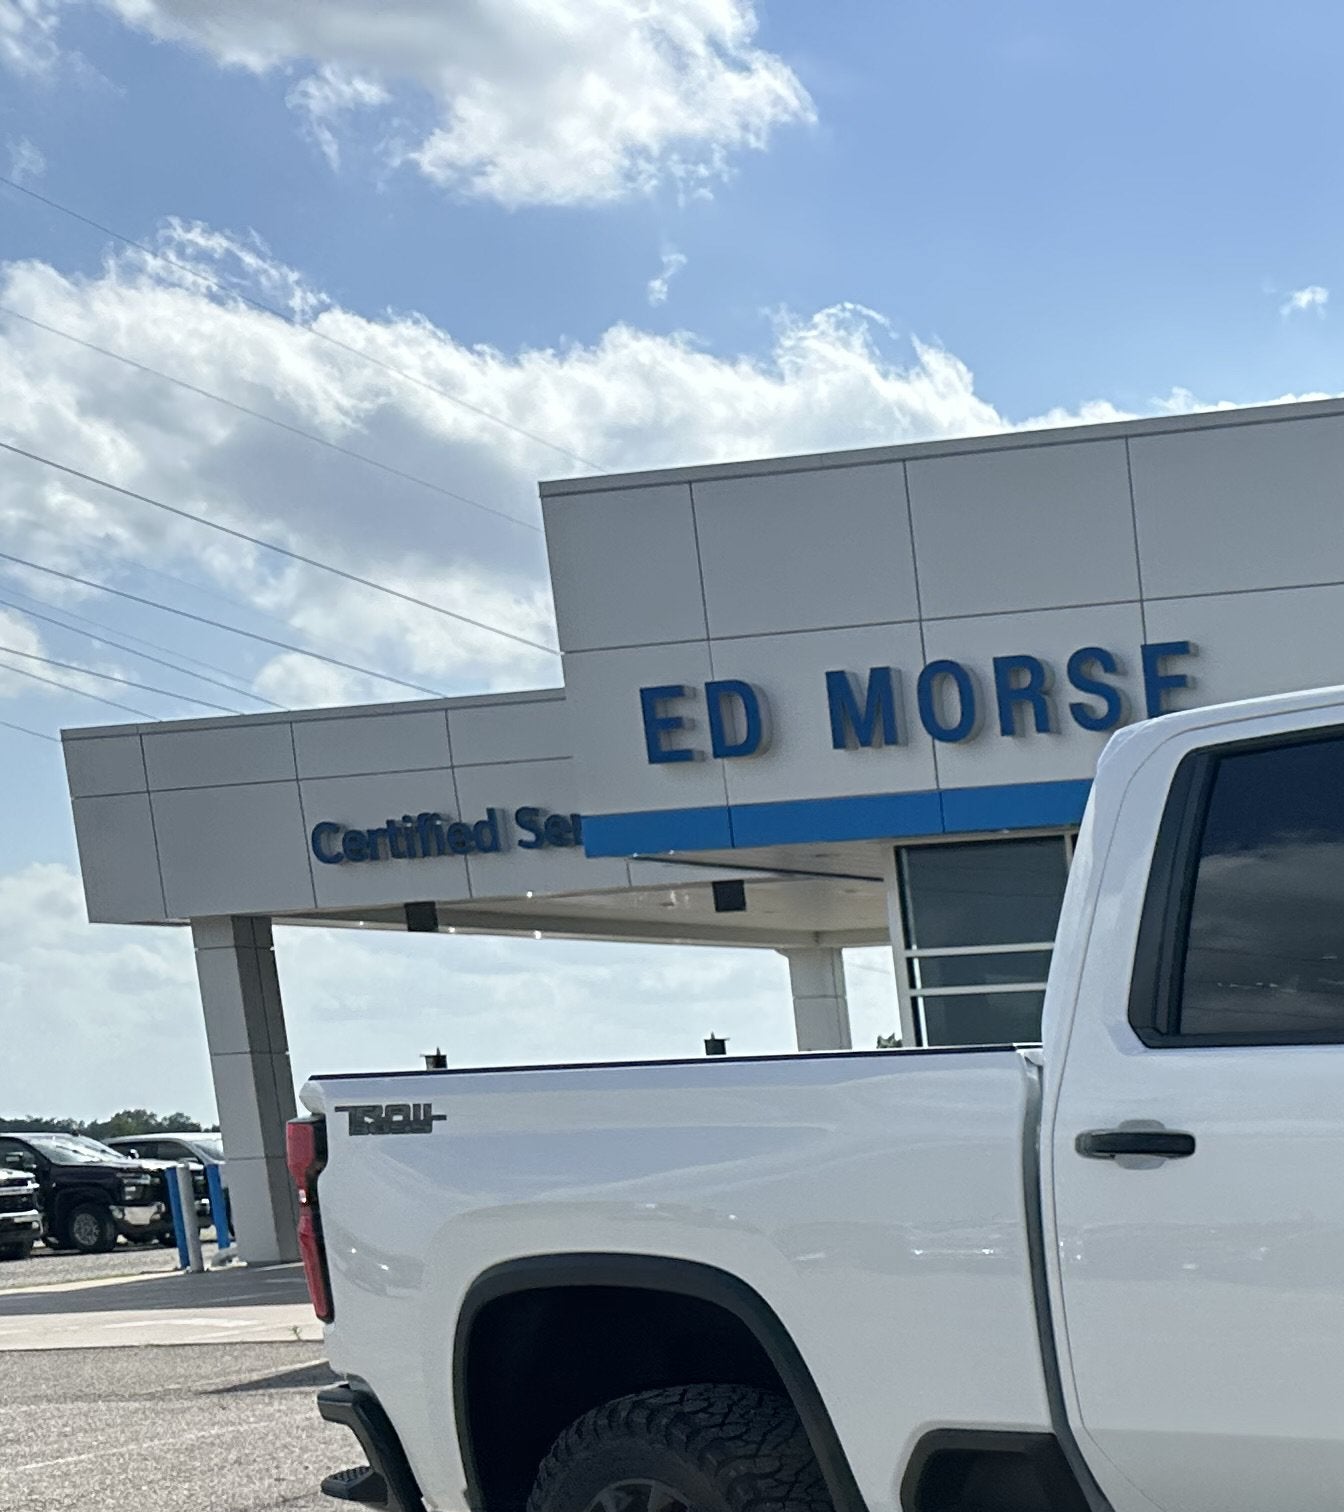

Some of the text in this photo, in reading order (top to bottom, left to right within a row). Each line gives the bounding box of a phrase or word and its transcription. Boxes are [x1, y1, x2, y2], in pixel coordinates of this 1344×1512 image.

[640, 641, 1192, 764] ED MORSE
[311, 807, 501, 864] Certified
